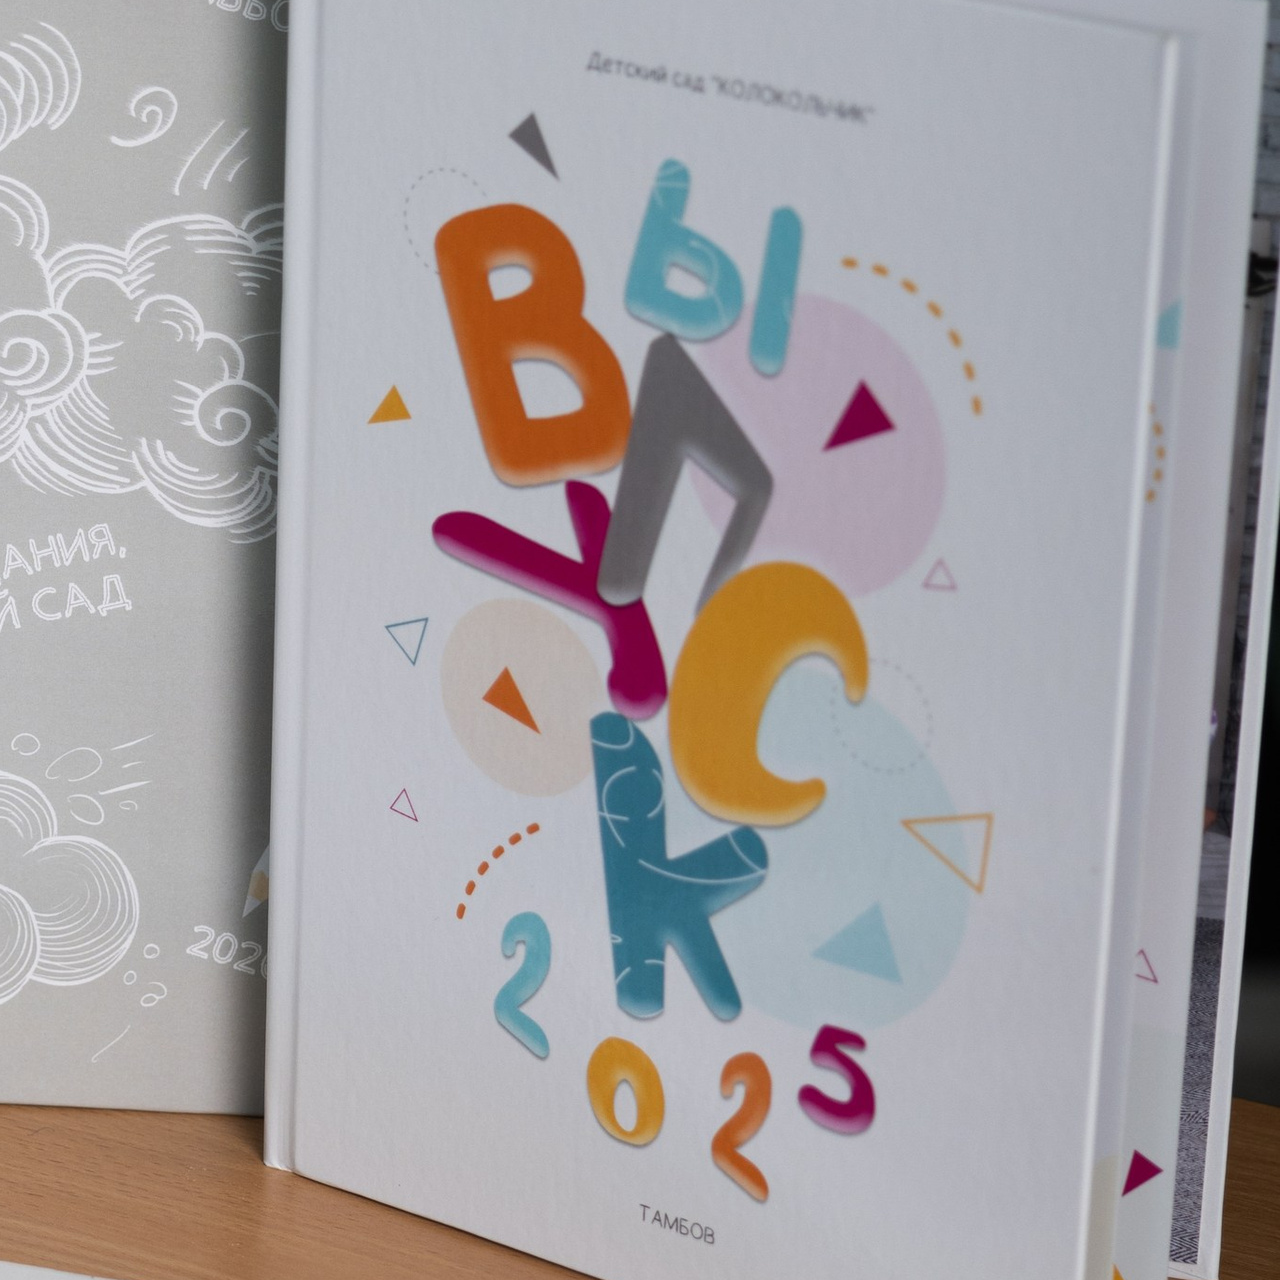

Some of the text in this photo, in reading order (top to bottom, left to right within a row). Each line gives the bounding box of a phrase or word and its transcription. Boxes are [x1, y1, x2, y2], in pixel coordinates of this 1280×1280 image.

[586, 50, 668, 84] Детский
[672, 71, 706, 95] сад
[32, 574, 133, 621] САД
[639, 1203, 715, 1245] ТАМБОВ
